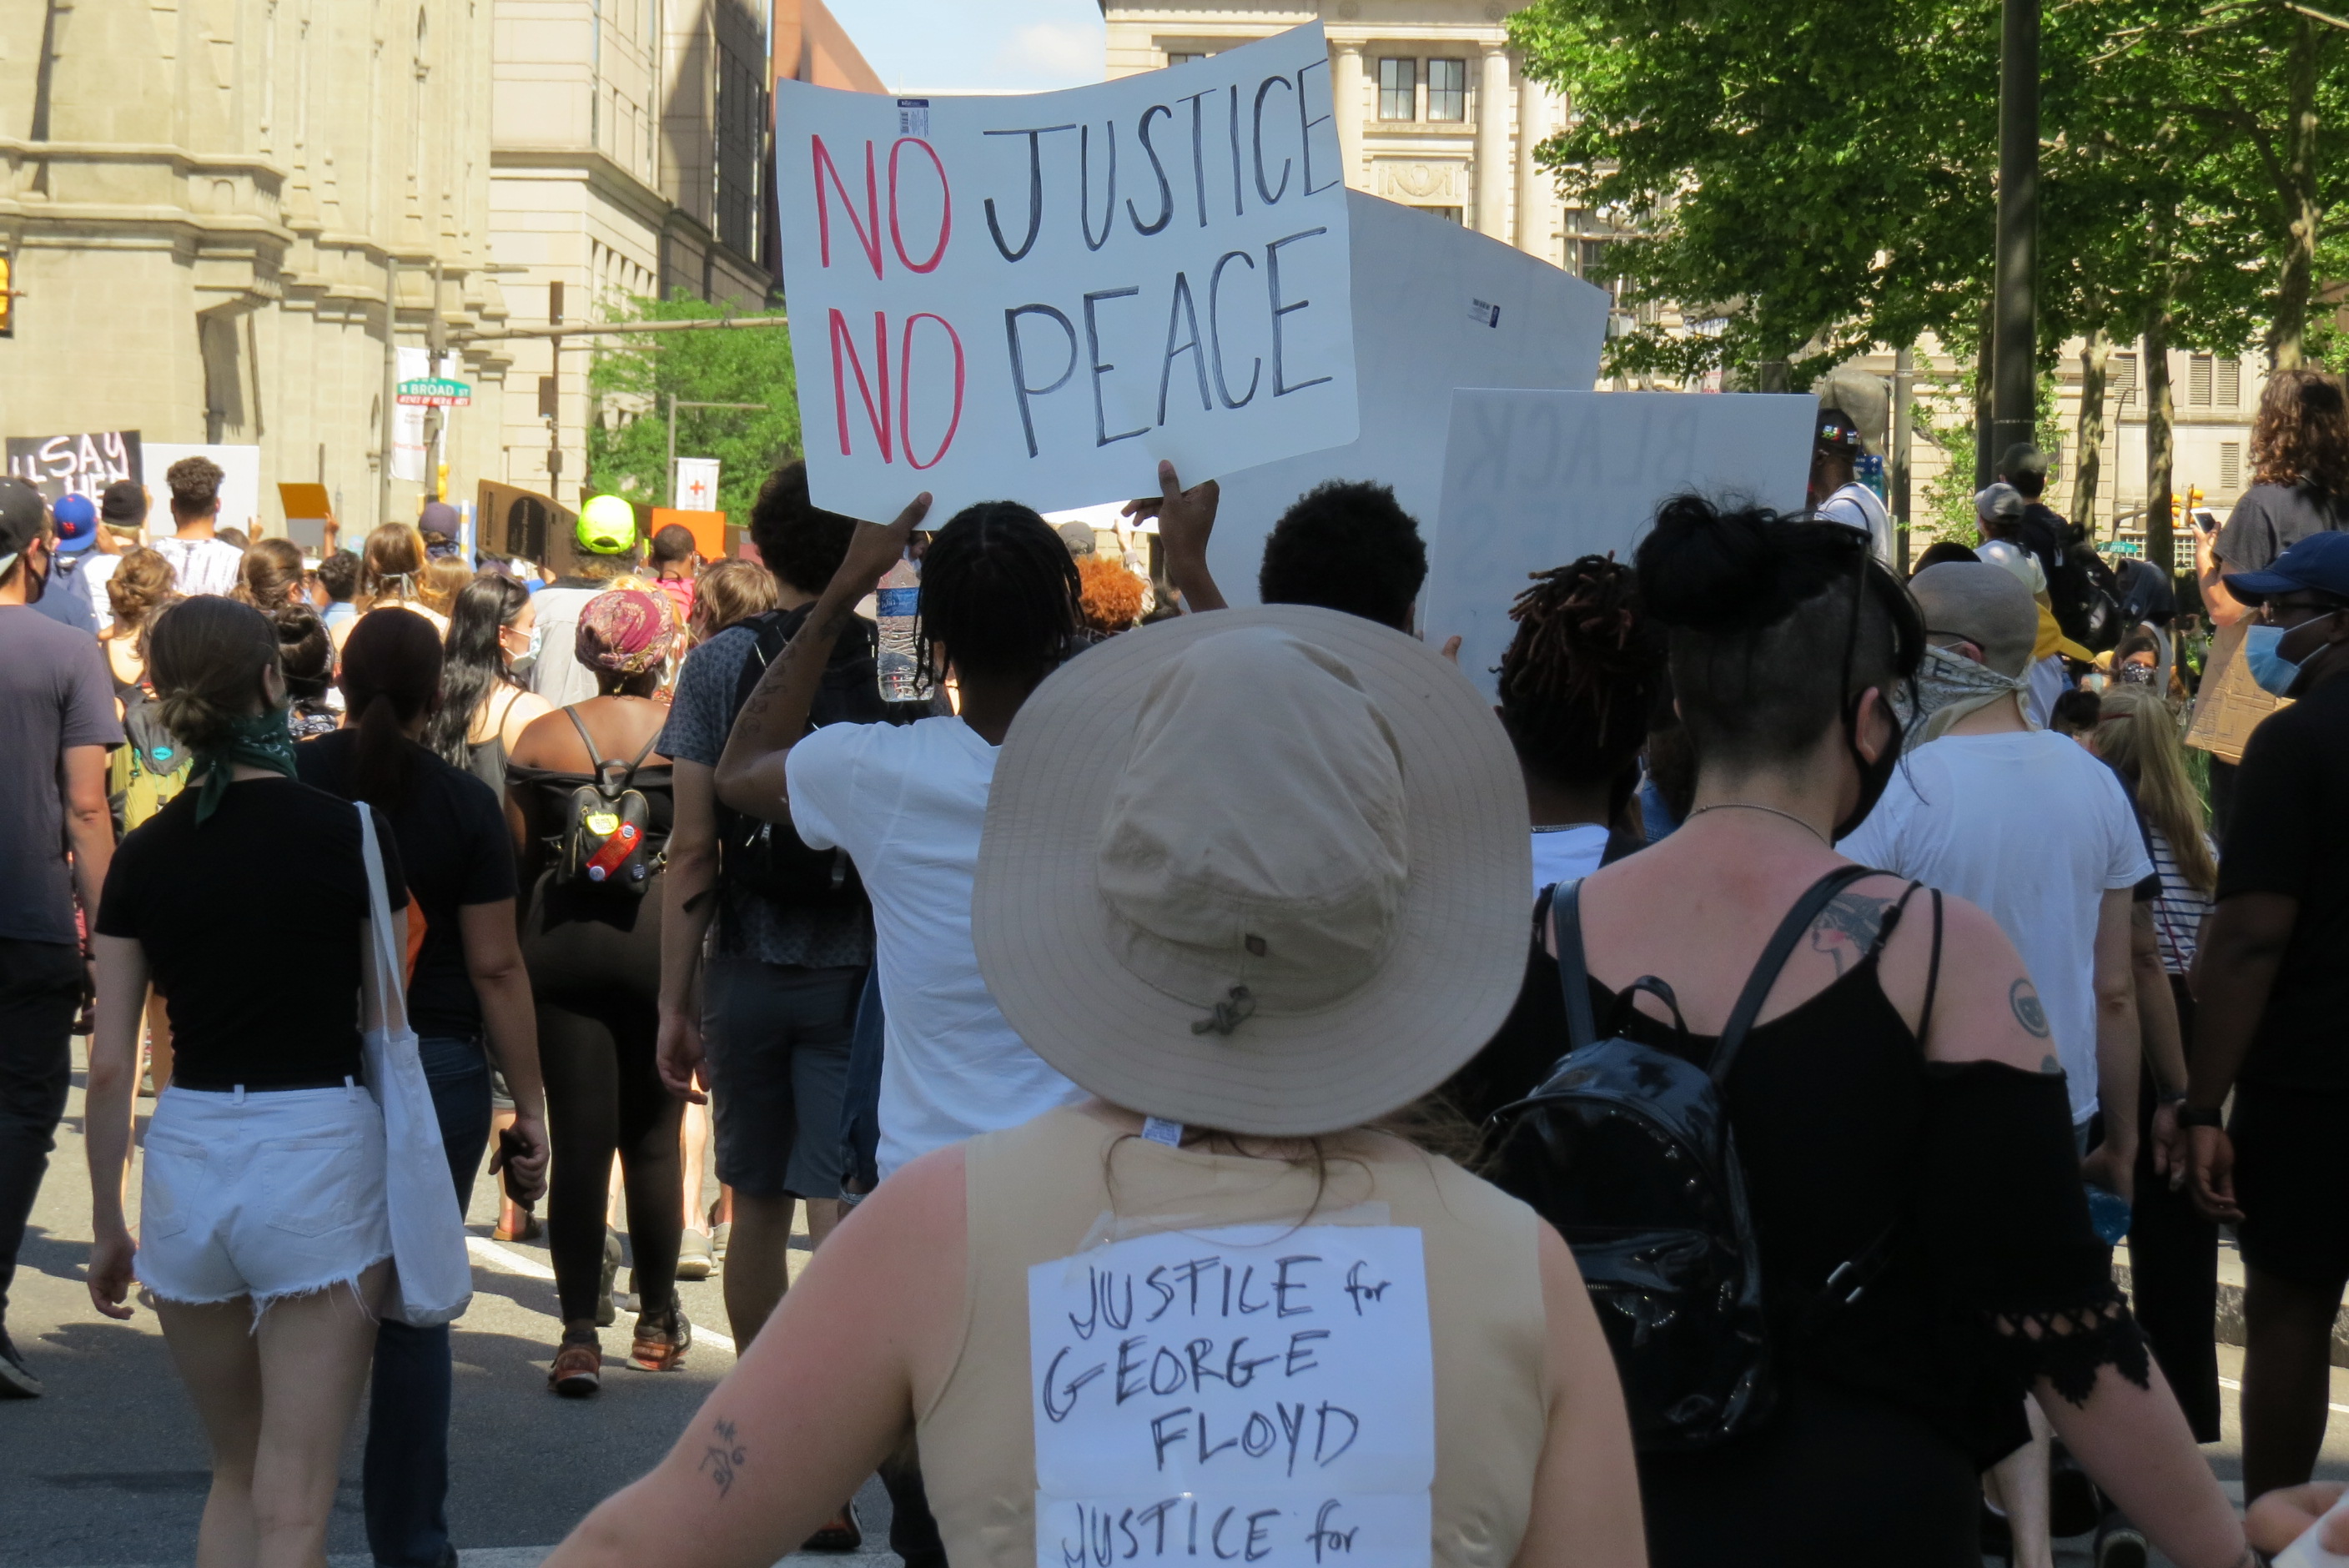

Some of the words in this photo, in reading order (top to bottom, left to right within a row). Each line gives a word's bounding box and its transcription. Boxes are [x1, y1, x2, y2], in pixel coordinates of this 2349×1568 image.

[812, 133, 951, 281] NO
[983, 58, 1340, 264] JUSTICE
[827, 307, 965, 470] NO
[1004, 226, 1333, 459] PEACE
[410, 384, 455, 396] BROAD
[39, 432, 129, 481] SAY
[1069, 1255, 1322, 1339] JUSTICE
[1345, 1260, 1392, 1315] for
[1043, 1329, 1331, 1423] GEORGE
[1149, 1400, 1360, 1478] FLOYD
[1061, 1496, 1282, 1568] JUSTICE
[1305, 1499, 1361, 1565] for
